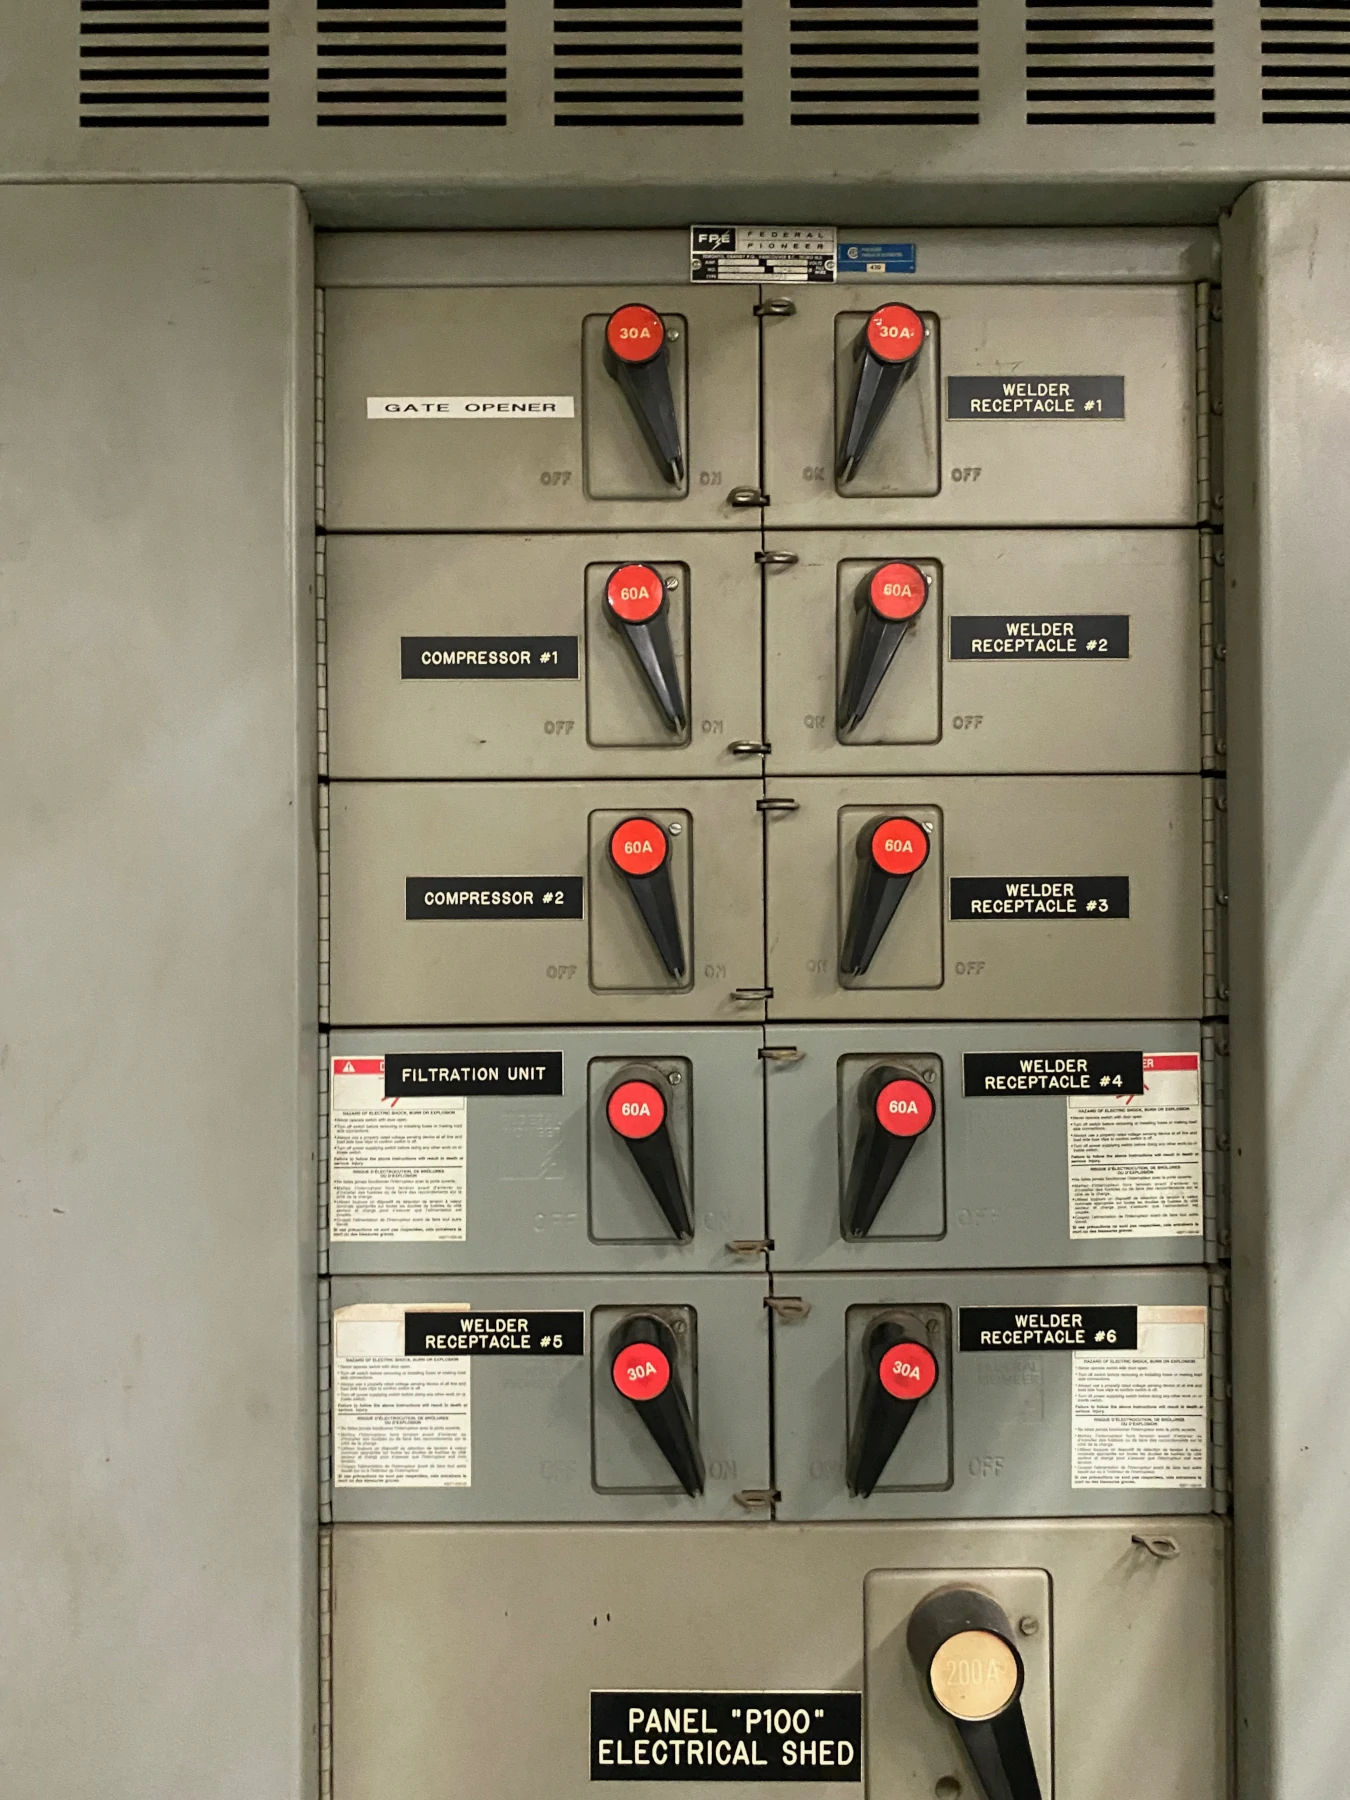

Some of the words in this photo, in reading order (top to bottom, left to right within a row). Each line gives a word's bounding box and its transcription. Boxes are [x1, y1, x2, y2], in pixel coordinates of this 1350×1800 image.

[619, 327, 651, 339] 30A
[880, 327, 910, 339] 30A
[1002, 383, 1070, 397] WELDER
[384, 402, 450, 413] GATE
[465, 402, 556, 413] OPENER
[970, 399, 1075, 413] RECEPTACLE
[1084, 399, 1102, 412] #1
[540, 471, 572, 486] OFF
[699, 471, 722, 486] ON
[950, 467, 982, 483] OFF
[620, 587, 649, 601] 60A
[883, 584, 912, 598] 60A
[1006, 623, 1074, 636] WELDER
[971, 639, 1077, 652] RECEPTACLE
[1085, 639, 1108, 652] #2
[421, 651, 531, 665] COMPRESSOR
[539, 651, 559, 664] #1
[544, 721, 575, 735] OFF
[702, 720, 724, 734] ON
[952, 715, 984, 730] OFF
[624, 841, 652, 854] 60A
[884, 839, 913, 853] 60A
[1006, 884, 1074, 897] WELDER
[424, 892, 534, 905] COMPRESSOR
[542, 891, 564, 905] #2
[971, 900, 1077, 913] RECEPTACLE
[1085, 899, 1109, 913] #3
[546, 965, 577, 979] OFF
[955, 961, 986, 975] OFF
[1019, 1059, 1088, 1073] WELDER
[402, 1067, 499, 1082] FILTRATION
[507, 1066, 546, 1081] UNIT
[984, 1074, 1091, 1090] RECEPTACLE
[1099, 1074, 1123, 1088] #4
[621, 1103, 650, 1116] 60A
[889, 1101, 918, 1114] 60A
[460, 1319, 528, 1333] WELDER
[1015, 1314, 1083, 1328] WELDER
[425, 1335, 531, 1349] RECEPTACLE
[540, 1334, 563, 1349] #5
[980, 1329, 1086, 1345] RECEPTACLE
[1094, 1329, 1117, 1344] #6
[627, 1361, 657, 1381] 30A
[892, 1360, 921, 1381] 30A
[709, 1460, 737, 1480] ON
[968, 1456, 1004, 1478] OFF
[946, 1659, 1001, 1686] 200A
[628, 1708, 718, 1733] PANEL
[731, 1708, 825, 1734] "P100"
[597, 1739, 767, 1766] ELECTRICAL
[781, 1739, 854, 1766] SHED
